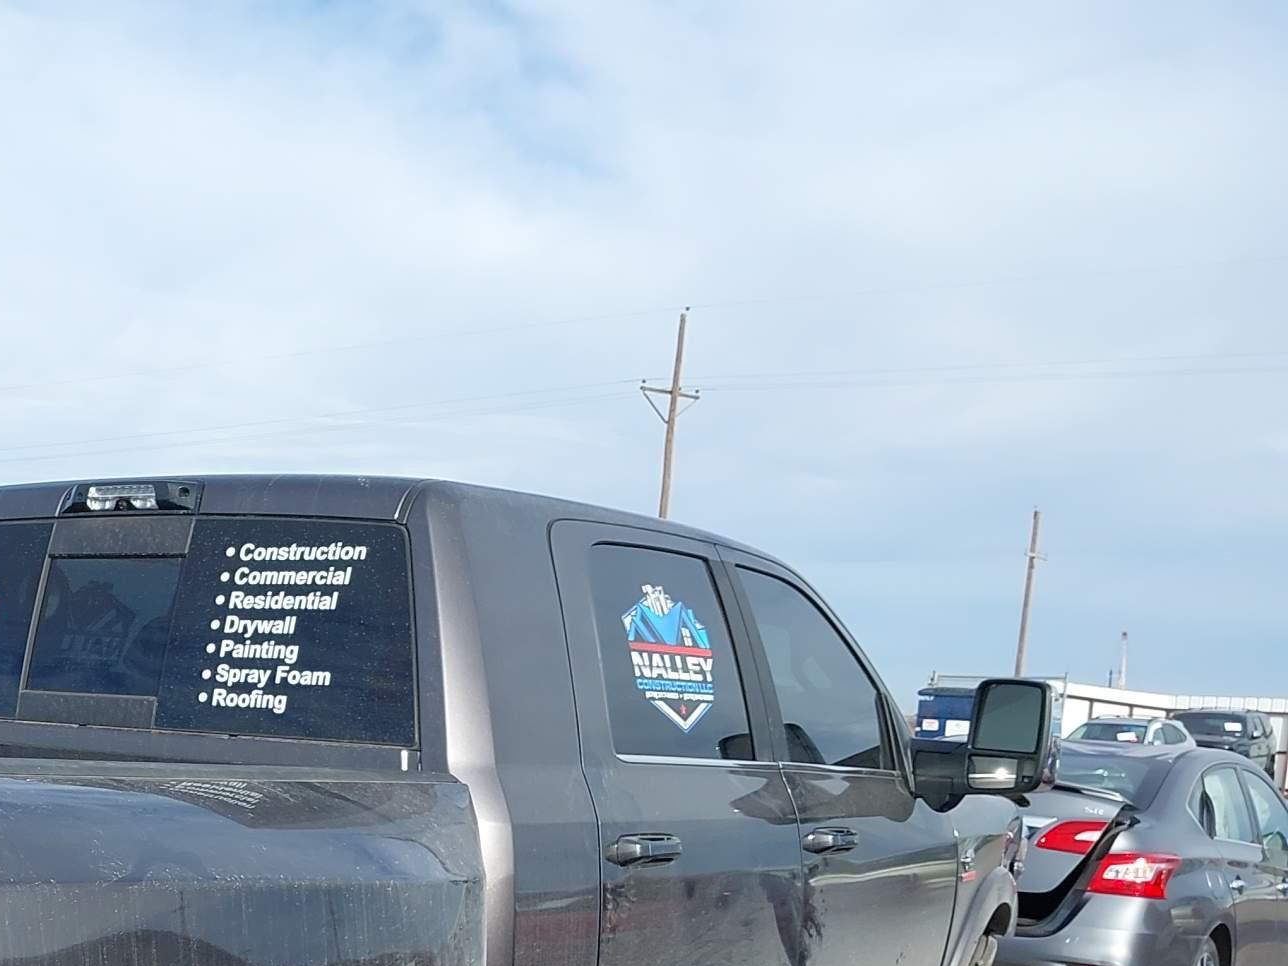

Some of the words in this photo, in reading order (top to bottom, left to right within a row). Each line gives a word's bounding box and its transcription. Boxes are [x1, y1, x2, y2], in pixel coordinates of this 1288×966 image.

[239, 542, 367, 561] Construction
[234, 566, 353, 585] Commercial
[228, 590, 339, 610] Residential
[224, 615, 297, 638] Drywall
[219, 639, 299, 664] Painting
[215, 664, 272, 688] Spray
[274, 665, 332, 686] Foam
[631, 651, 713, 682] NALLEY
[212, 688, 288, 714] Roofing
